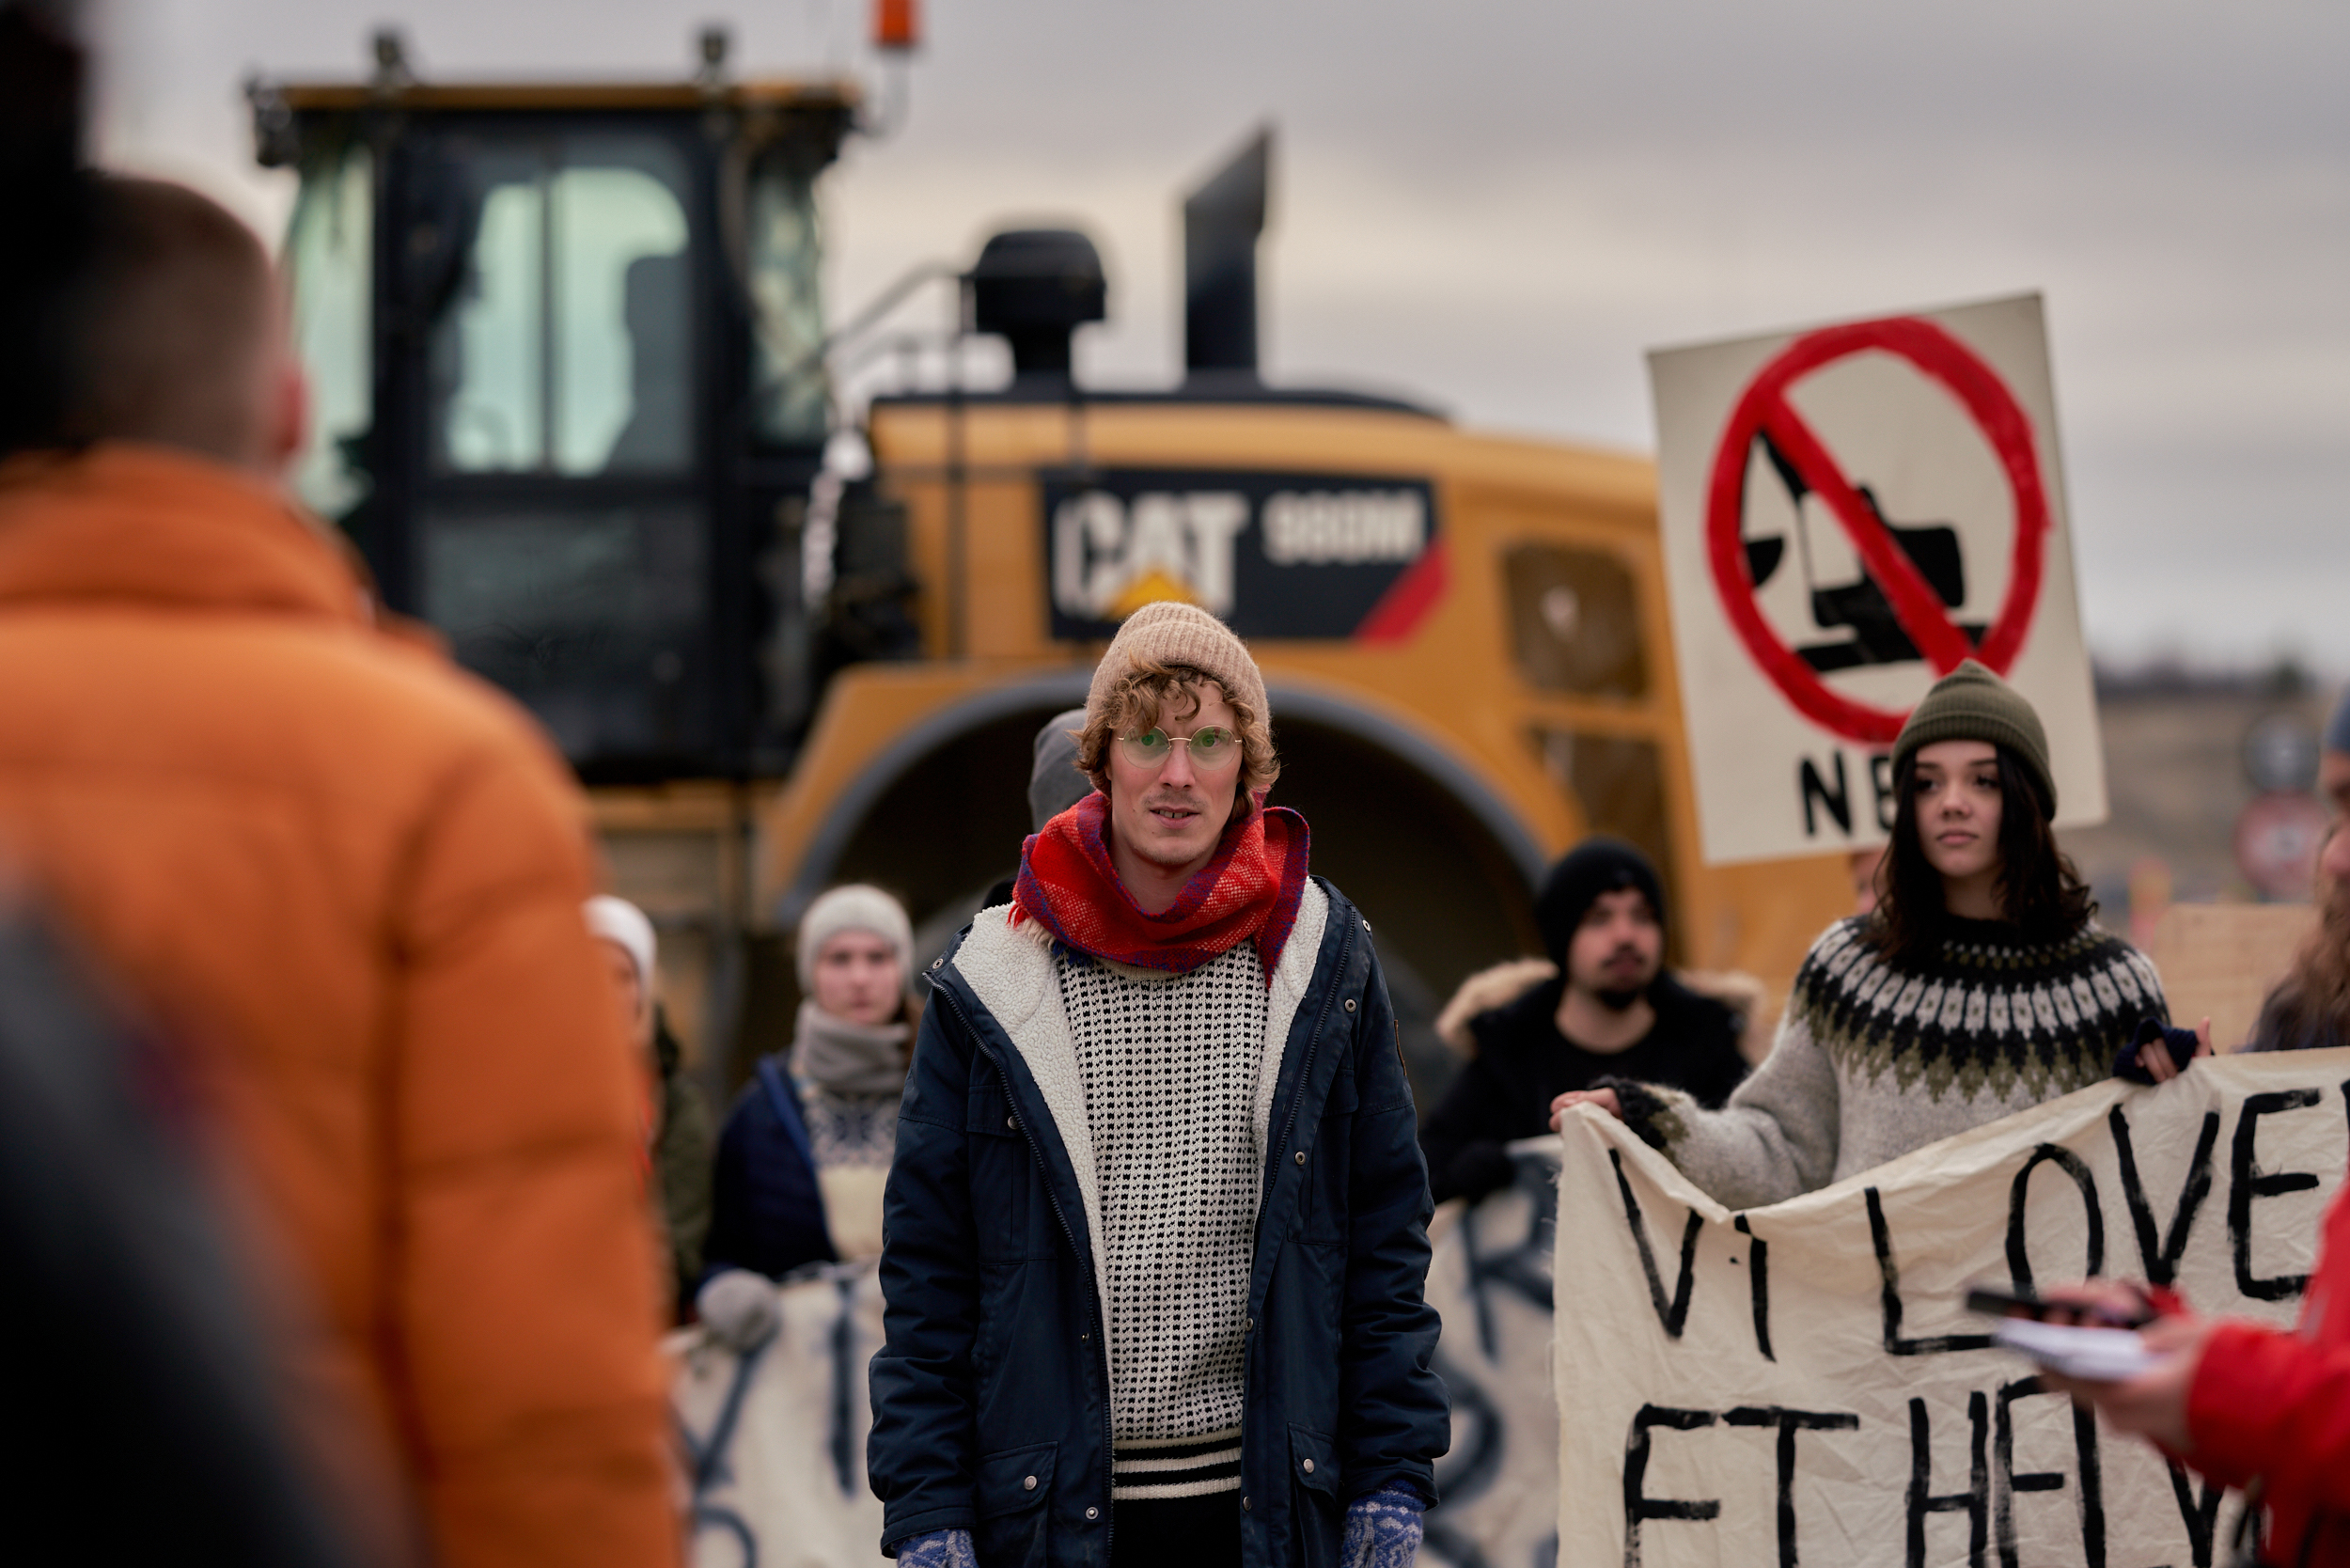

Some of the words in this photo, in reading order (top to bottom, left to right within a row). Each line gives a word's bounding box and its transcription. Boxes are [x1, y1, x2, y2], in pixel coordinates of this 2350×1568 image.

[1052, 490, 1251, 619] CAT
[1800, 750, 1898, 835] NE
[1864, 1079, 2350, 1356] LOVE
